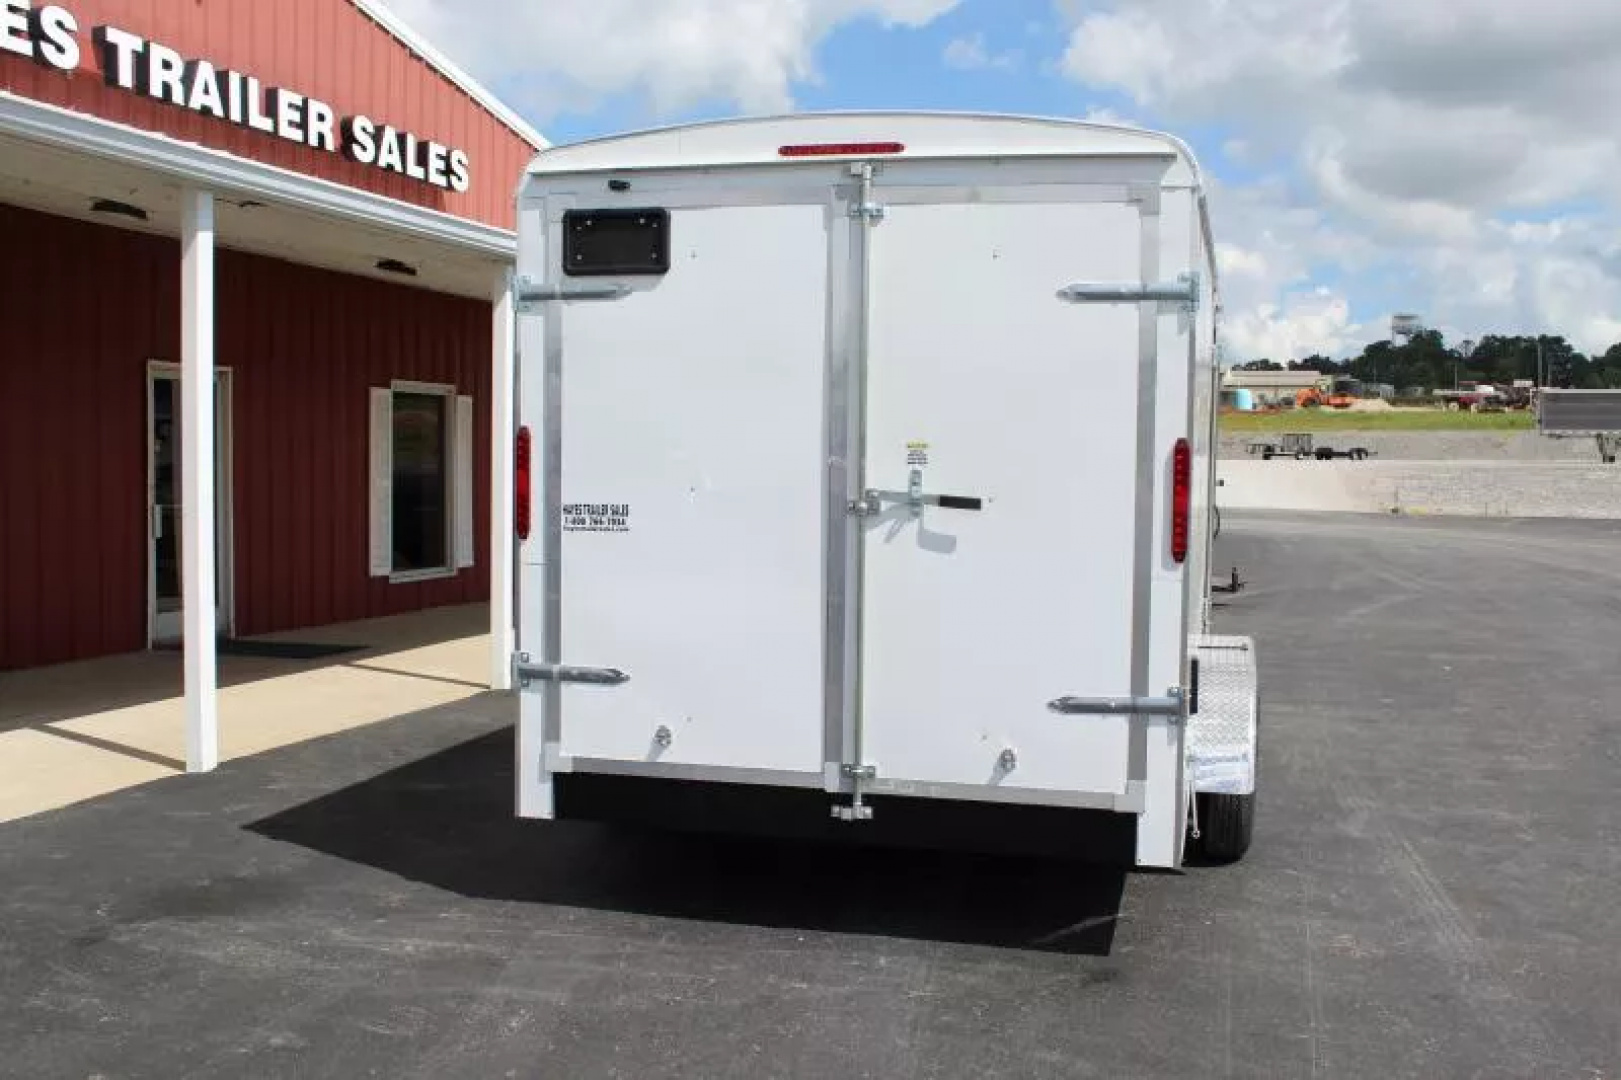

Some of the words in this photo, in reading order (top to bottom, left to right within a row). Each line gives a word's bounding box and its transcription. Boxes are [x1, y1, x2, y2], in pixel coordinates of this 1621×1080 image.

[104, 26, 335, 152] TRAILER
[351, 114, 469, 192] SALES
[583, 504, 608, 516] TRAILER
[610, 504, 629, 517] SALES
